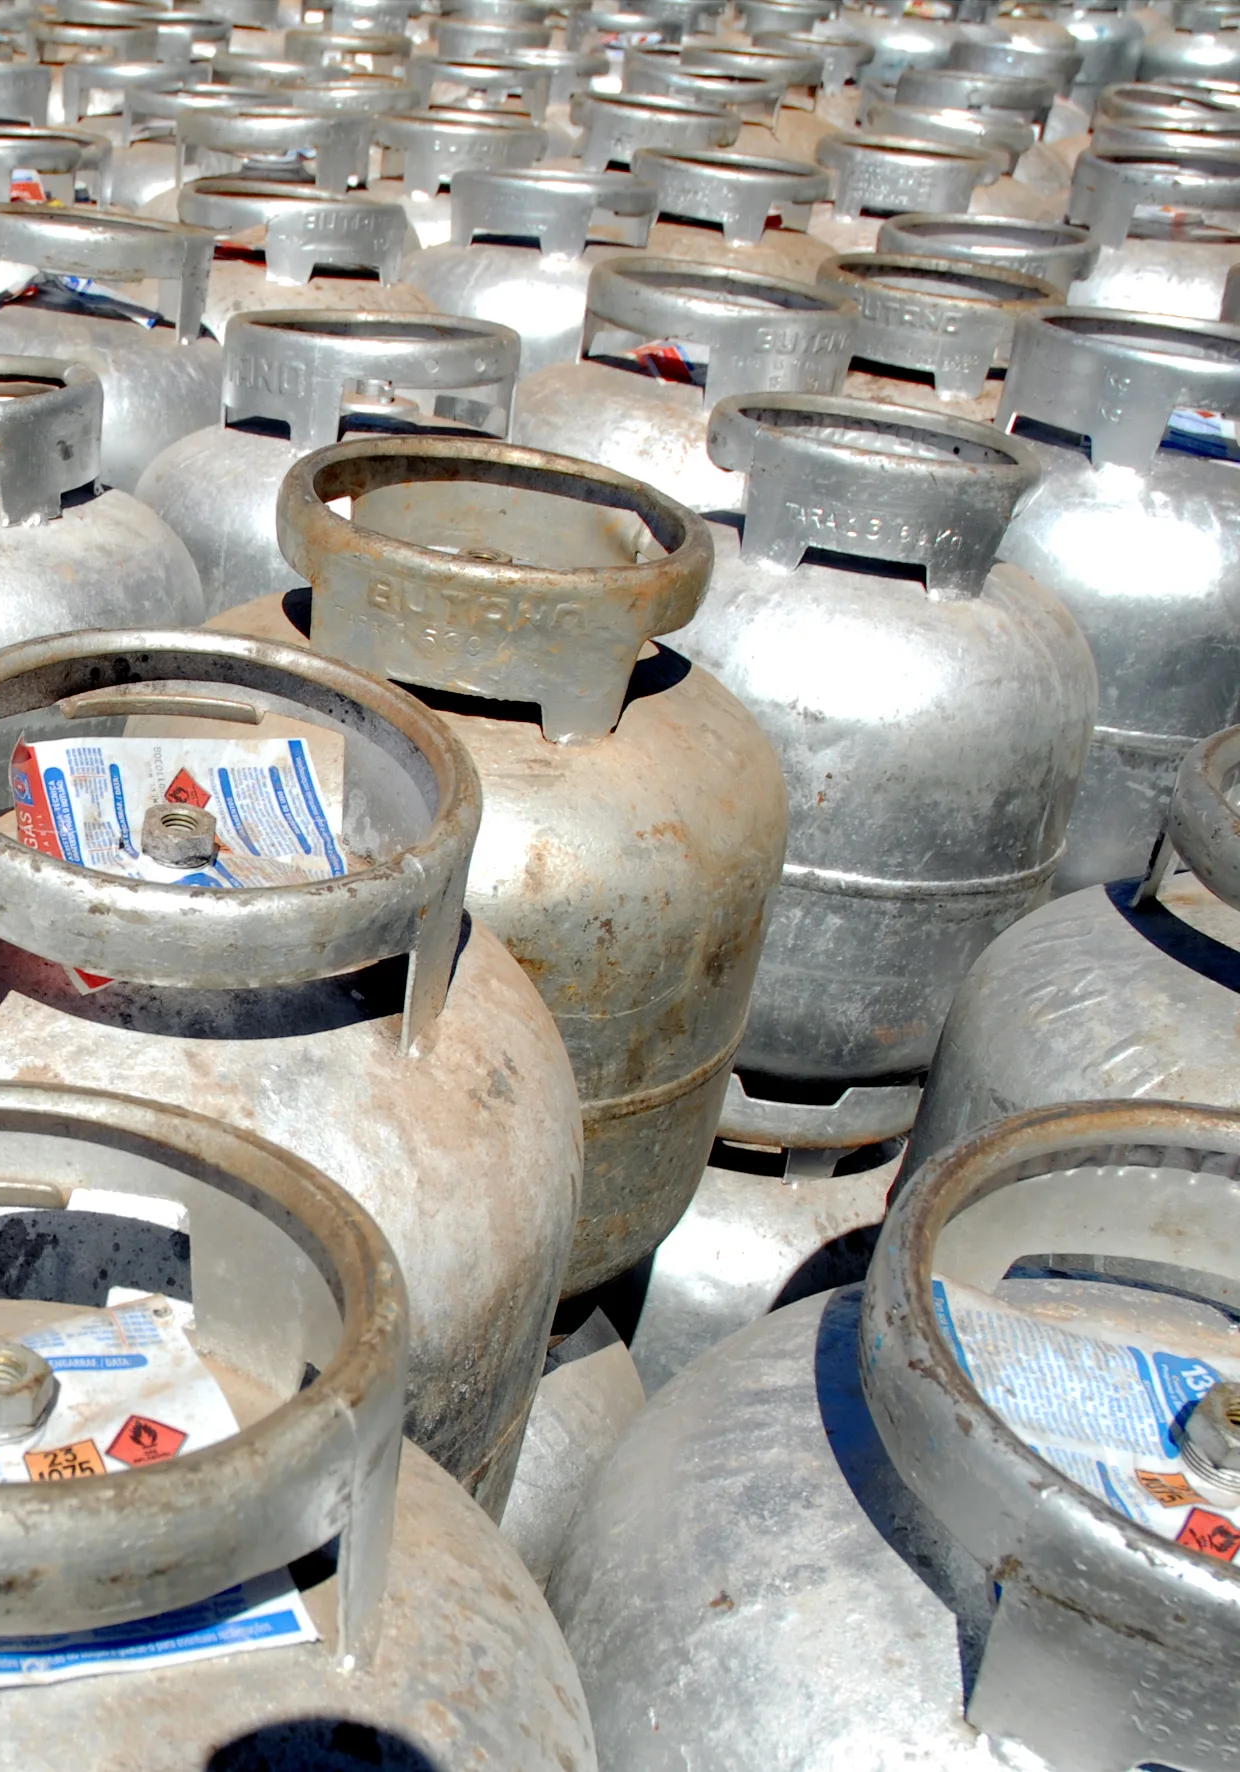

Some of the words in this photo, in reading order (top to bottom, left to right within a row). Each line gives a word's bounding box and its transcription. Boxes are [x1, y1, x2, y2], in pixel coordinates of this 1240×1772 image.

[786, 501, 837, 532] TARA
[368, 579, 588, 632] BUTANO
[45, 1448, 78, 1469] 23
